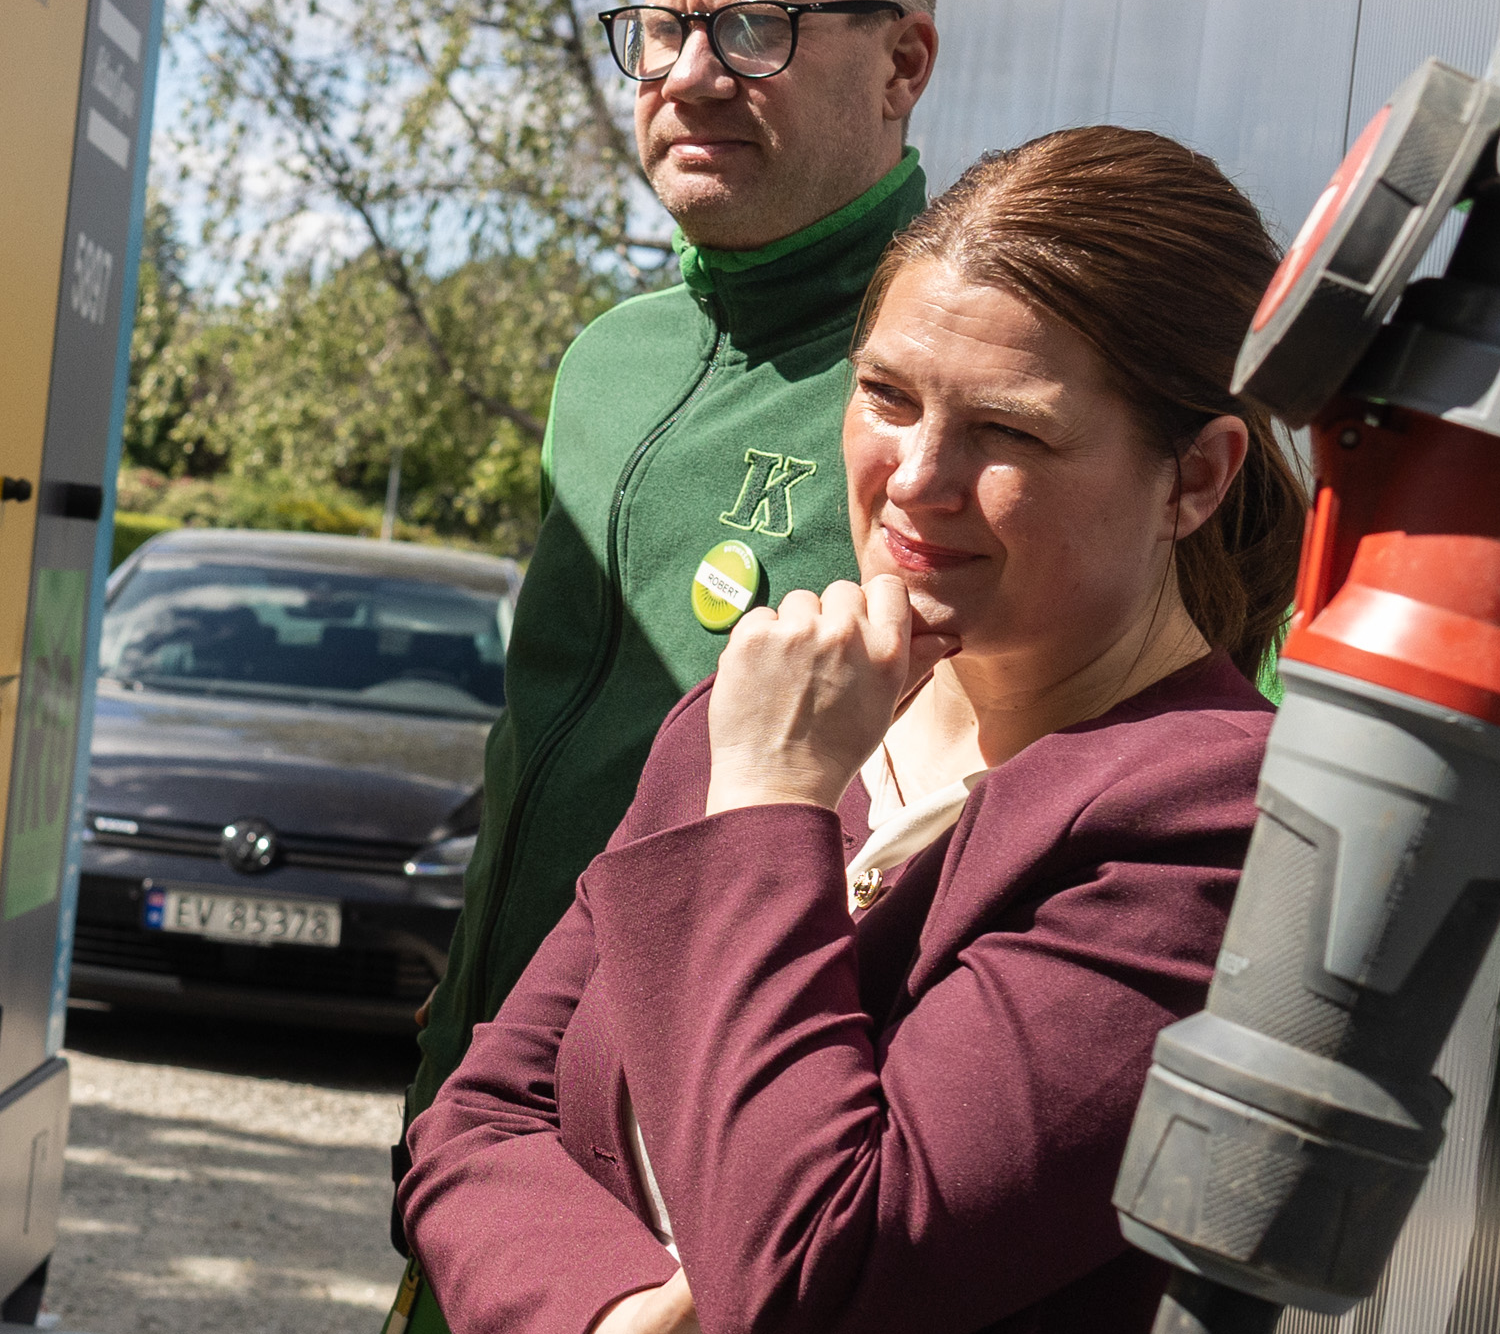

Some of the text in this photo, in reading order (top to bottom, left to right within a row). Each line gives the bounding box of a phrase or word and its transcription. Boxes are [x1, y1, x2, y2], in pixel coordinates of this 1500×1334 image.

[719, 447, 819, 538] K
[707, 573, 739, 598] ROBERT
[175, 896, 329, 941] EV 85378
